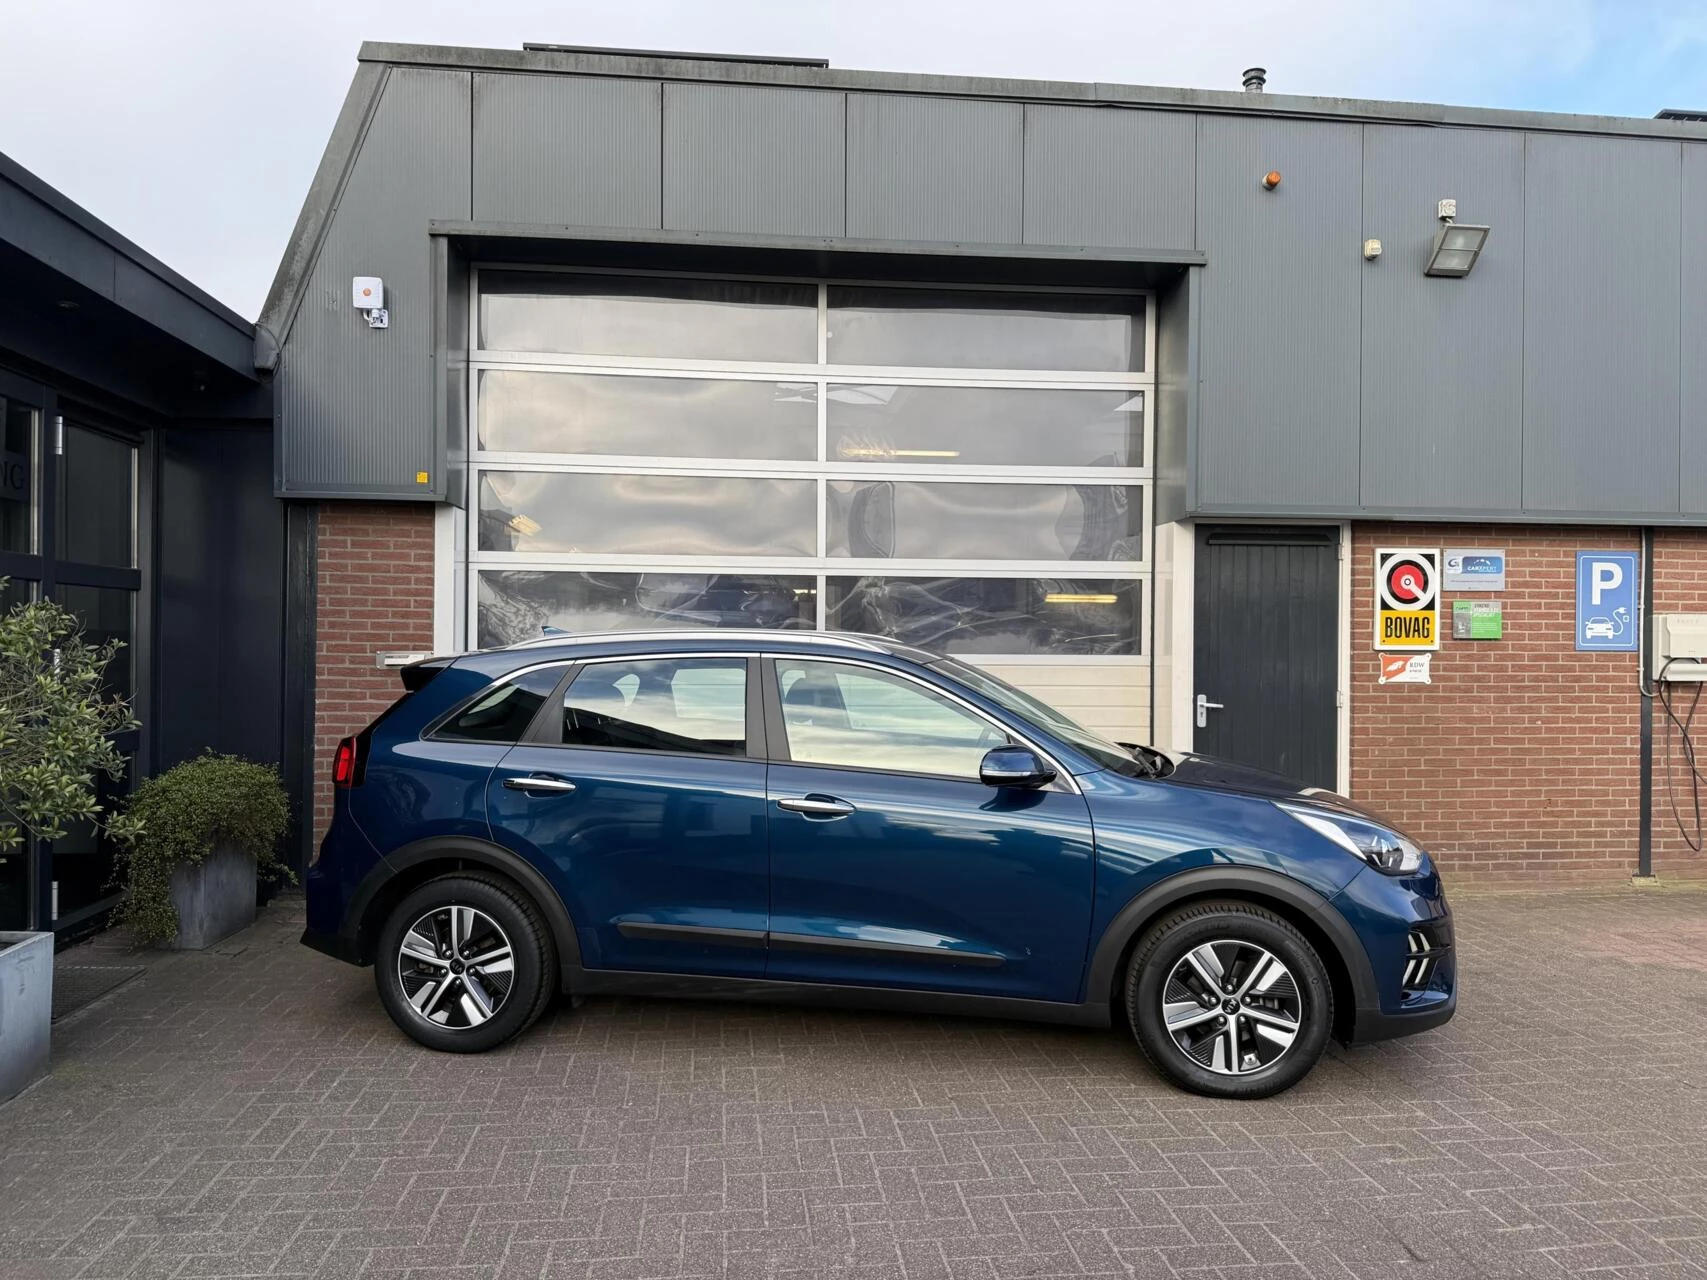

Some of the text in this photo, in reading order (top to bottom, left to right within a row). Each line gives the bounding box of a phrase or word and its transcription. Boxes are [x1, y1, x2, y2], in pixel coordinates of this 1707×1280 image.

[1592, 562, 1623, 605] P
[1385, 617, 1430, 638] BOVAG
[1225, 999, 1237, 1013] KIA
